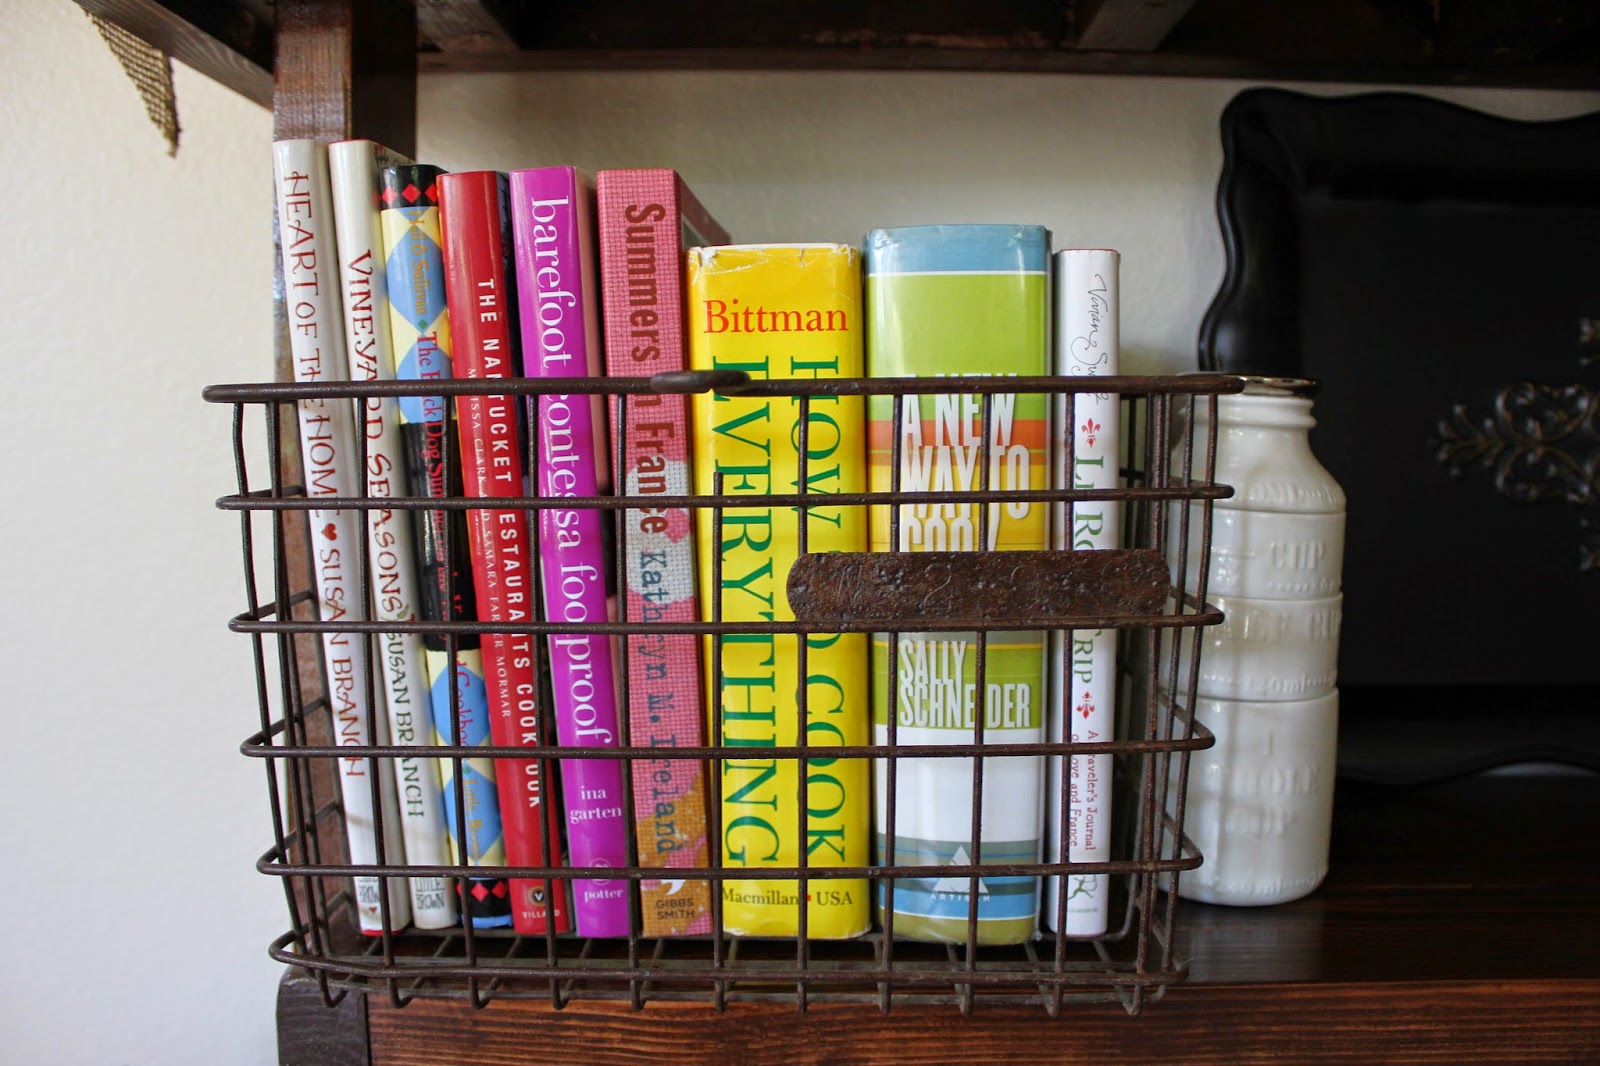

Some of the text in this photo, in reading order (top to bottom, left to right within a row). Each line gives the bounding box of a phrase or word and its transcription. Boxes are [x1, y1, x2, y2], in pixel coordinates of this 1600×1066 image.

[283, 171, 319, 296] HEART
[625, 203, 667, 363] Summers
[295, 301, 318, 339] OF
[703, 298, 849, 334] Bittman
[417, 331, 438, 367] The
[421, 371, 444, 421] Bck
[935, 372, 1018, 447] NEW
[420, 421, 444, 459] Dog
[531, 195, 613, 744] barefoot ontesa fooproof
[478, 278, 497, 322] THE
[499, 511, 532, 669] ESTAURATS
[516, 683, 541, 808] COOKOOK
[320, 548, 349, 646] SUSAN
[489, 596, 504, 648] FARER
[900, 639, 967, 684] SALLY
[900, 682, 1031, 728] SCHNEDER
[580, 785, 608, 801] ina
[1087, 754, 1098, 803] raveler's
[570, 806, 623, 825] garten
[522, 909, 560, 919] VILLAD
[583, 888, 624, 904] potter
[655, 897, 694, 910] GIBBS
[657, 909, 695, 921] SMITH
[721, 887, 853, 907] Macmillan USA
[930, 893, 991, 902] ARTISN
